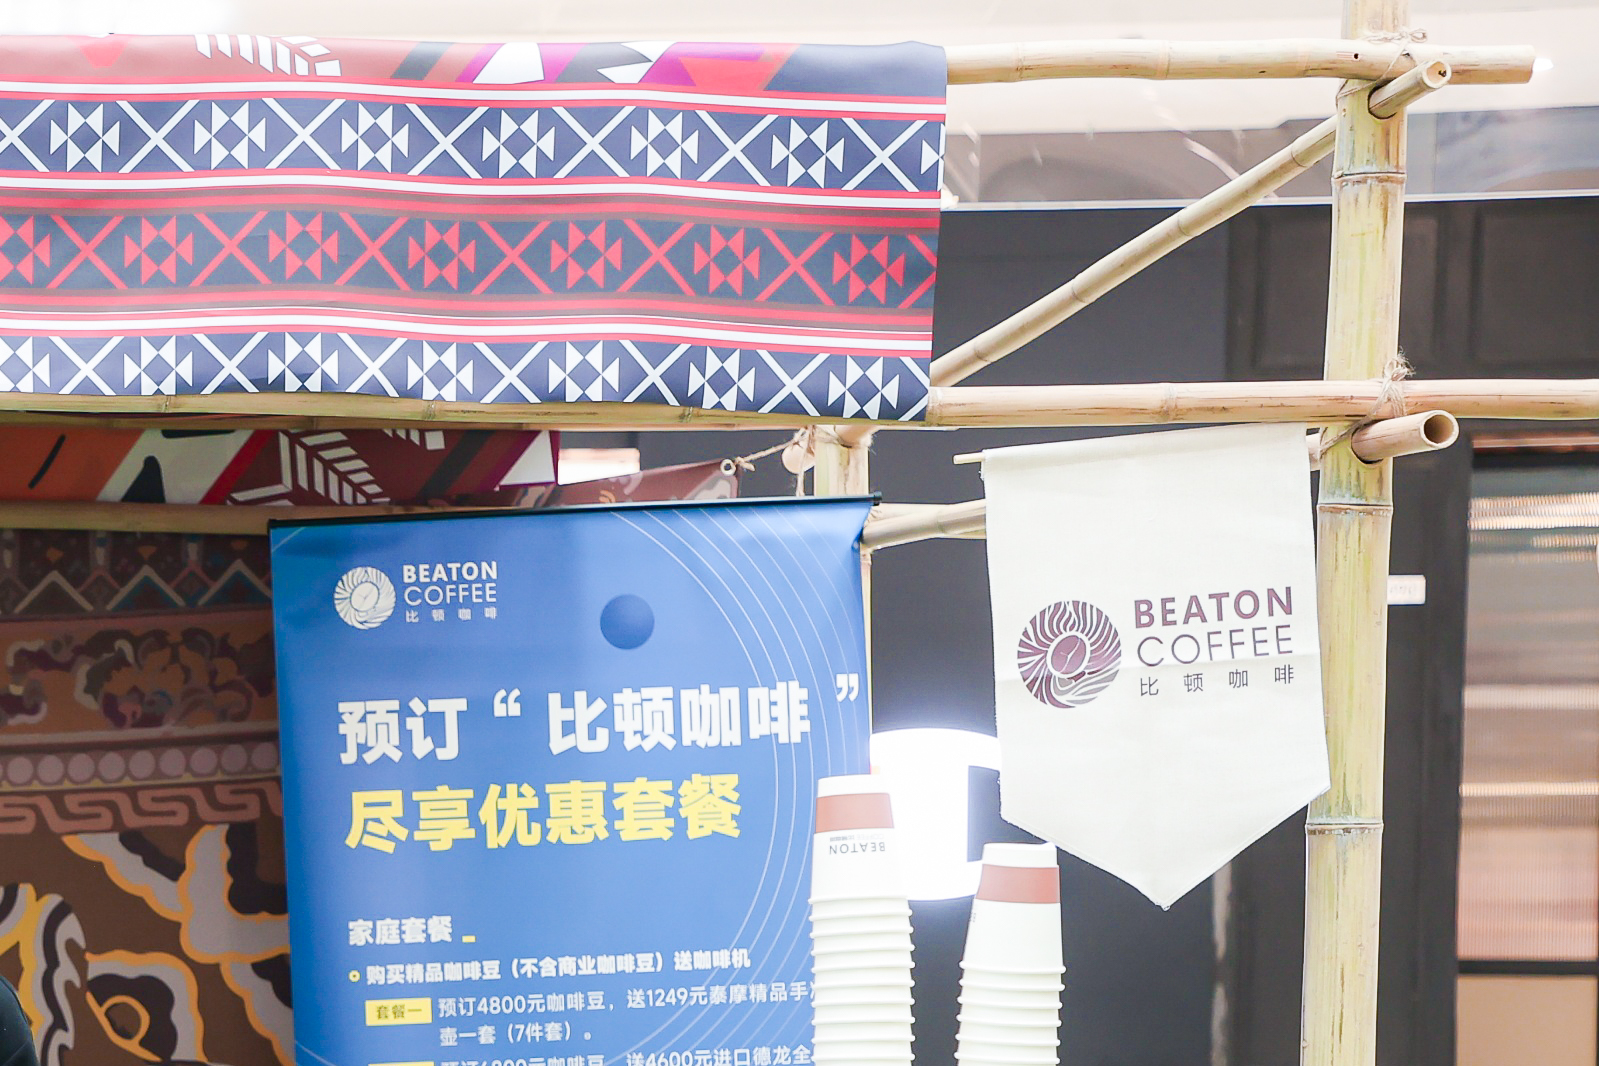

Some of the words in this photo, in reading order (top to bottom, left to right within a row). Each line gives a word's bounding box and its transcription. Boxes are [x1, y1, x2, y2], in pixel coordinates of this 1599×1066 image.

[402, 561, 497, 583] BEATON
[403, 582, 497, 606] COFFEE
[1134, 586, 1293, 629] BEATON
[405, 606, 497, 624] 比顿咖啡
[1137, 625, 1293, 667] COFFEE
[1140, 664, 1294, 697] 比顿咖啡
[345, 772, 741, 854] 尽享优惠套餐
[829, 842, 886, 855] BEATON
[348, 915, 453, 946] 家庭套餐
[376, 1004, 423, 1020] 套餐一
[438, 980, 814, 1018] 预订4800元咖啡豆，送1249元泰摩精品手
